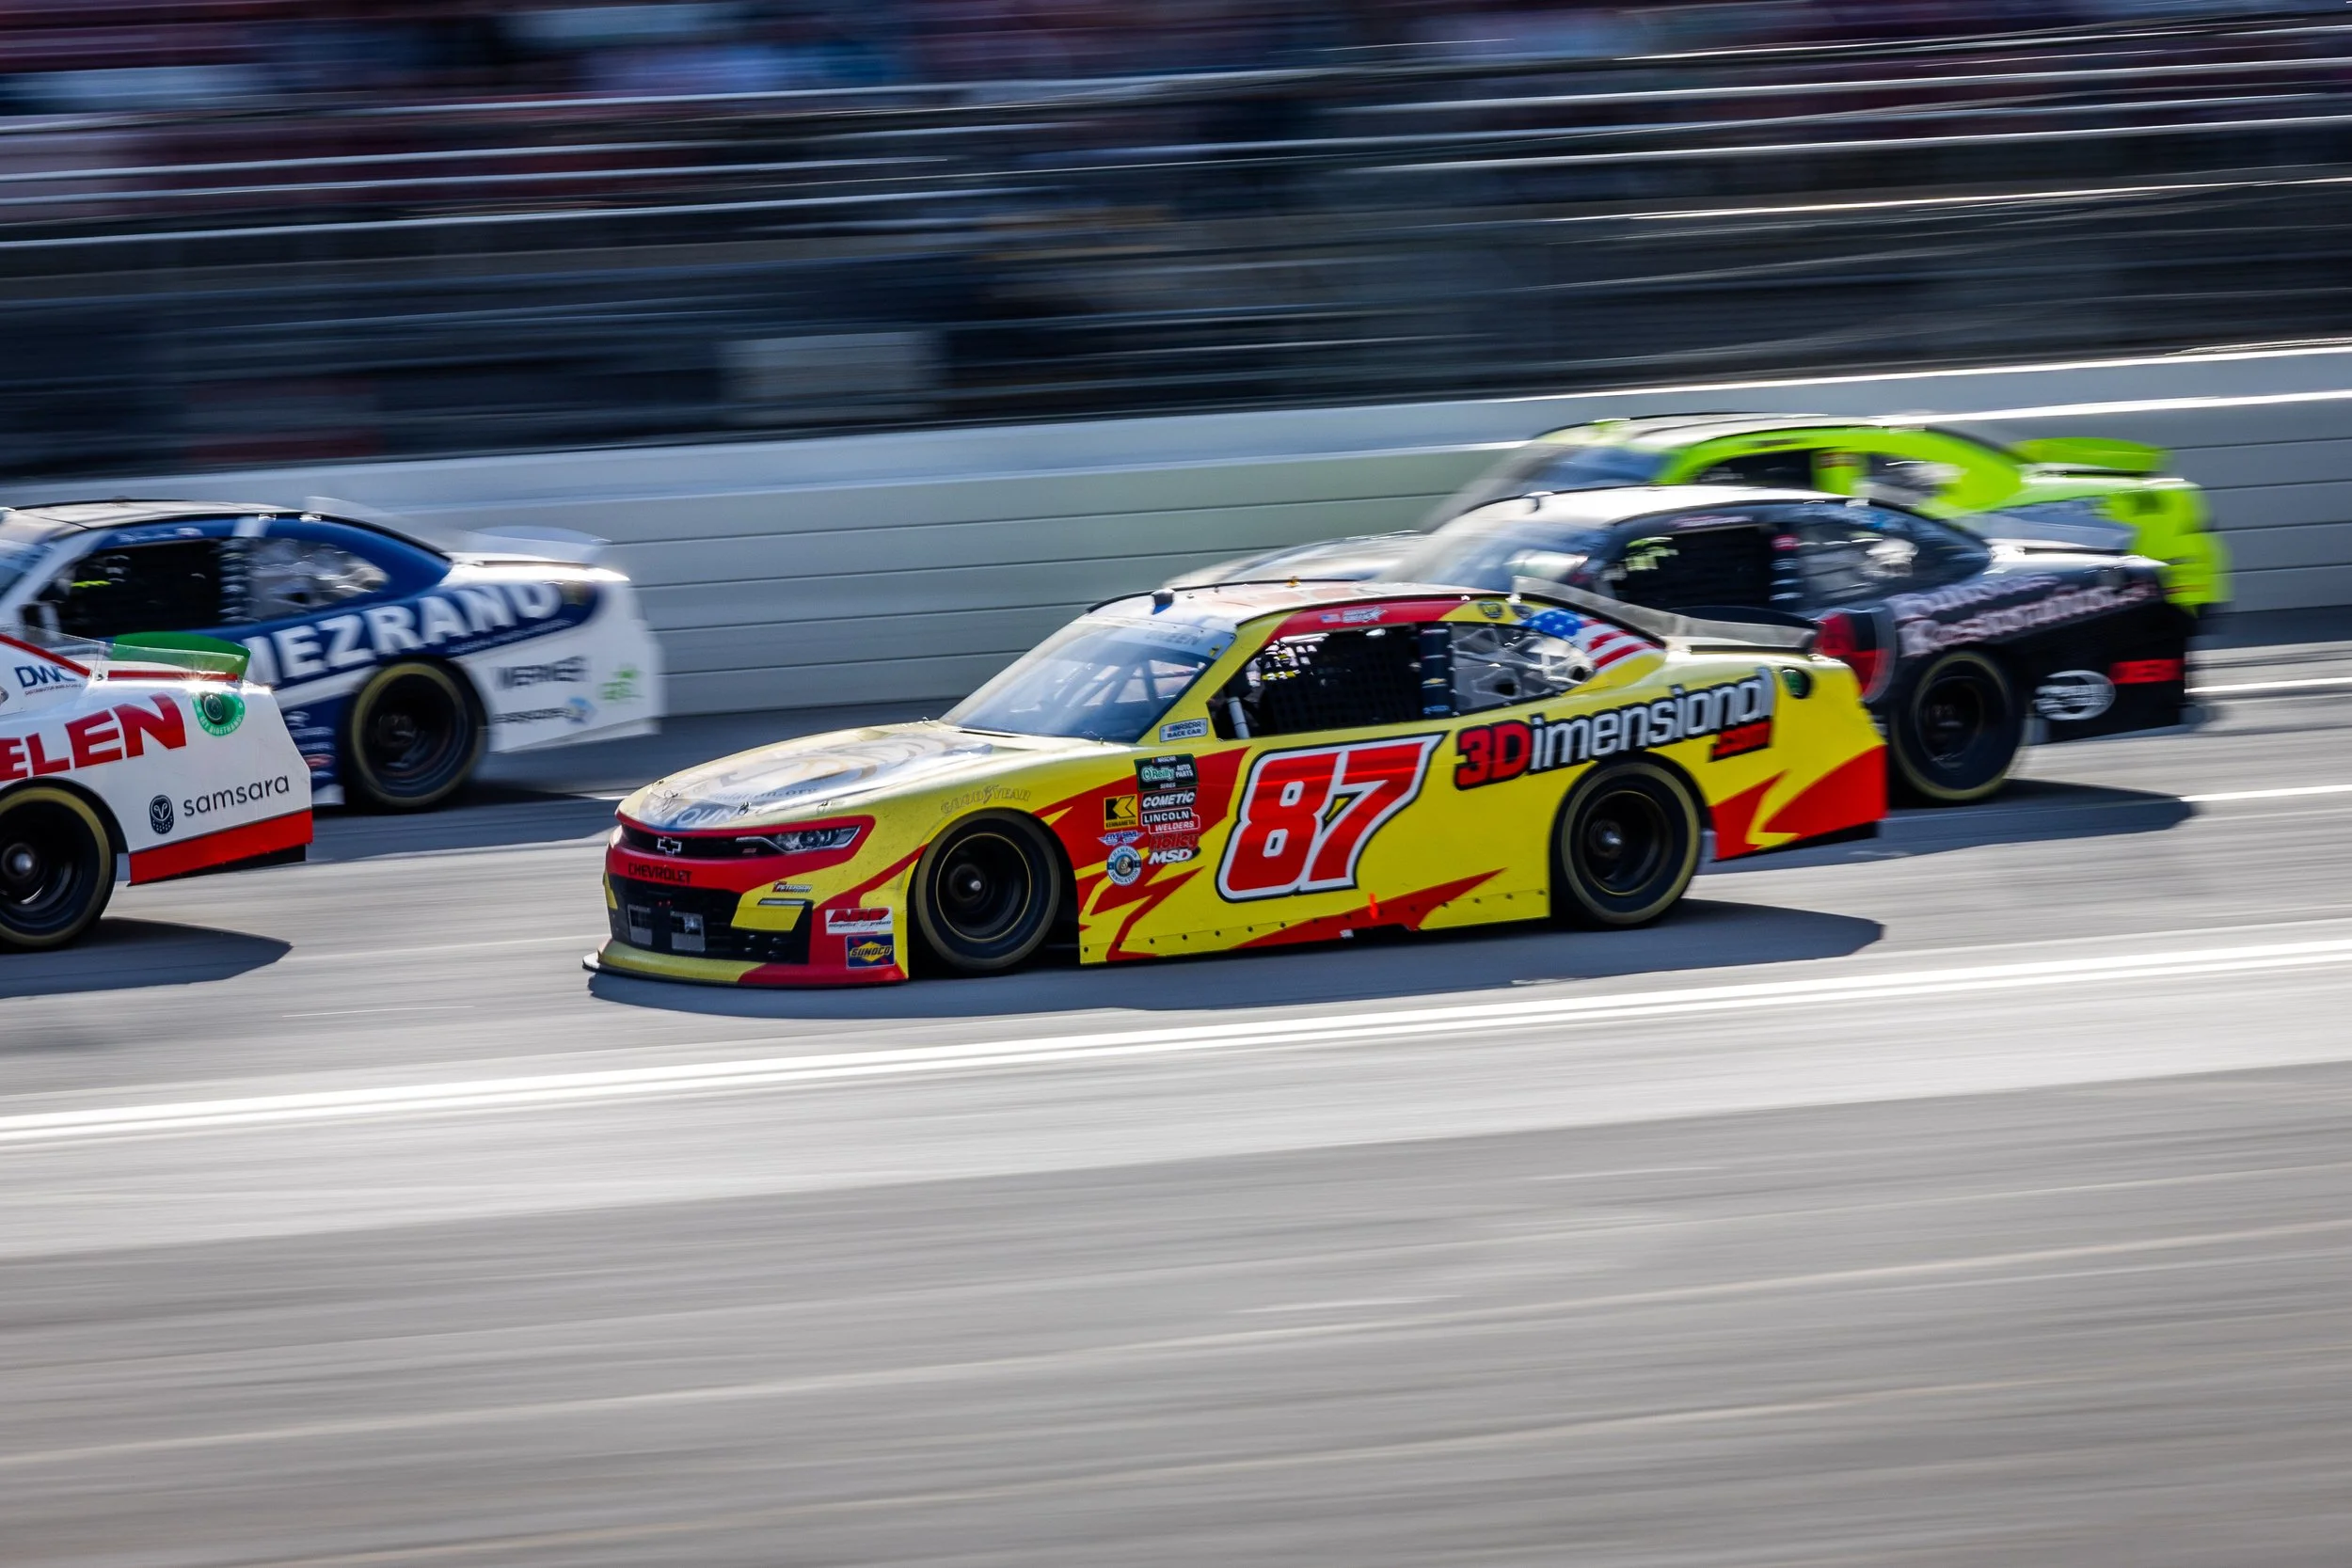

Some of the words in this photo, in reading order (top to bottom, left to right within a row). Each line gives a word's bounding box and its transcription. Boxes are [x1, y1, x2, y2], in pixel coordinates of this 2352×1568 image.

[1175, 770, 1194, 779] PARTS
[183, 775, 291, 817] samsara
[1142, 791, 1196, 808] COMETIC
[1144, 810, 1190, 823] LINCOLN
[1216, 731, 1450, 903] 87
[1155, 820, 1195, 832] WELDERS
[1148, 847, 1193, 865] MSD
[628, 863, 692, 883] CHEVROLET
[850, 945, 891, 958] SUNOCO
